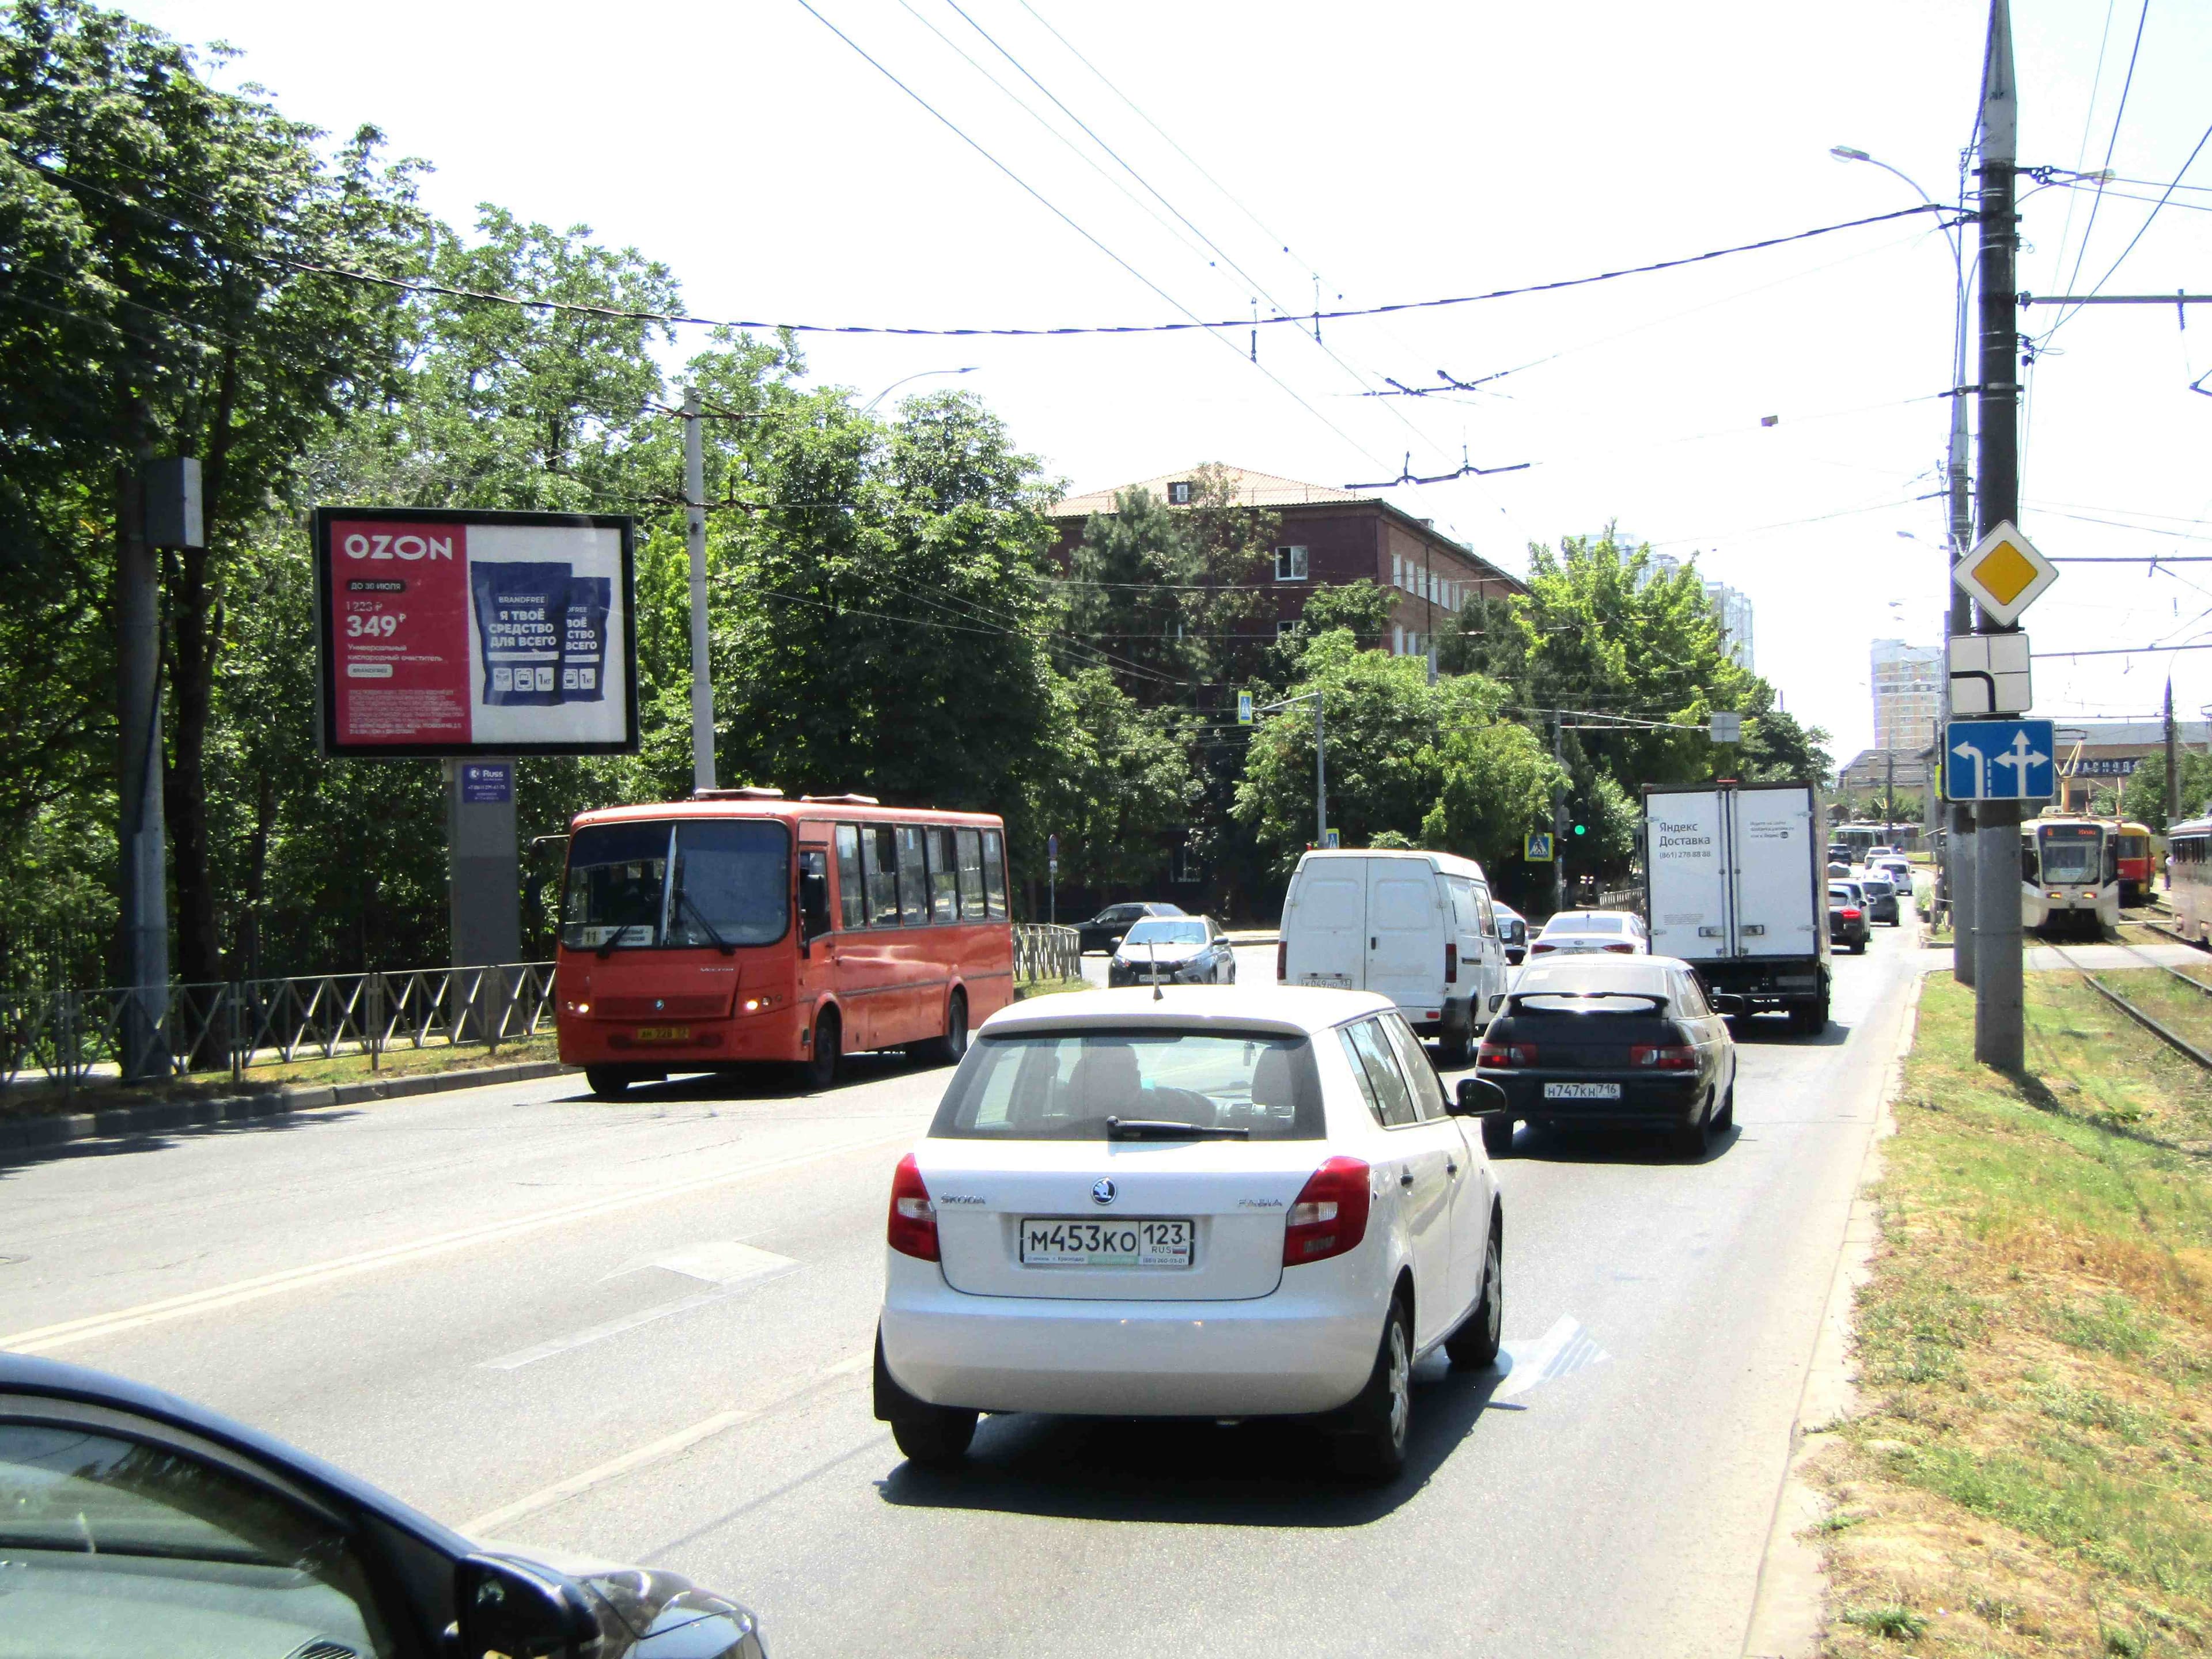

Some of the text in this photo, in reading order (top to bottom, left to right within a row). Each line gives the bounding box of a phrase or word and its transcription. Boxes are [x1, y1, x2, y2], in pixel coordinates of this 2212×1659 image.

[345, 534, 452, 560] OZON
[498, 596, 545, 604] BRANDFREE
[499, 608, 545, 620] Я ТВОЁ
[488, 623, 554, 635] СРЕДСТВО
[491, 636, 556, 648] ДЛЯ ВСЕГО
[566, 641, 597, 650] ВСЕГО
[483, 770, 503, 778] Russ
[1660, 822, 1698, 832] Яндекс
[1660, 835, 1710, 847] Доставка
[1237, 1199, 1282, 1207] FABIA
[1031, 1224, 1183, 1252] М453КО 123
